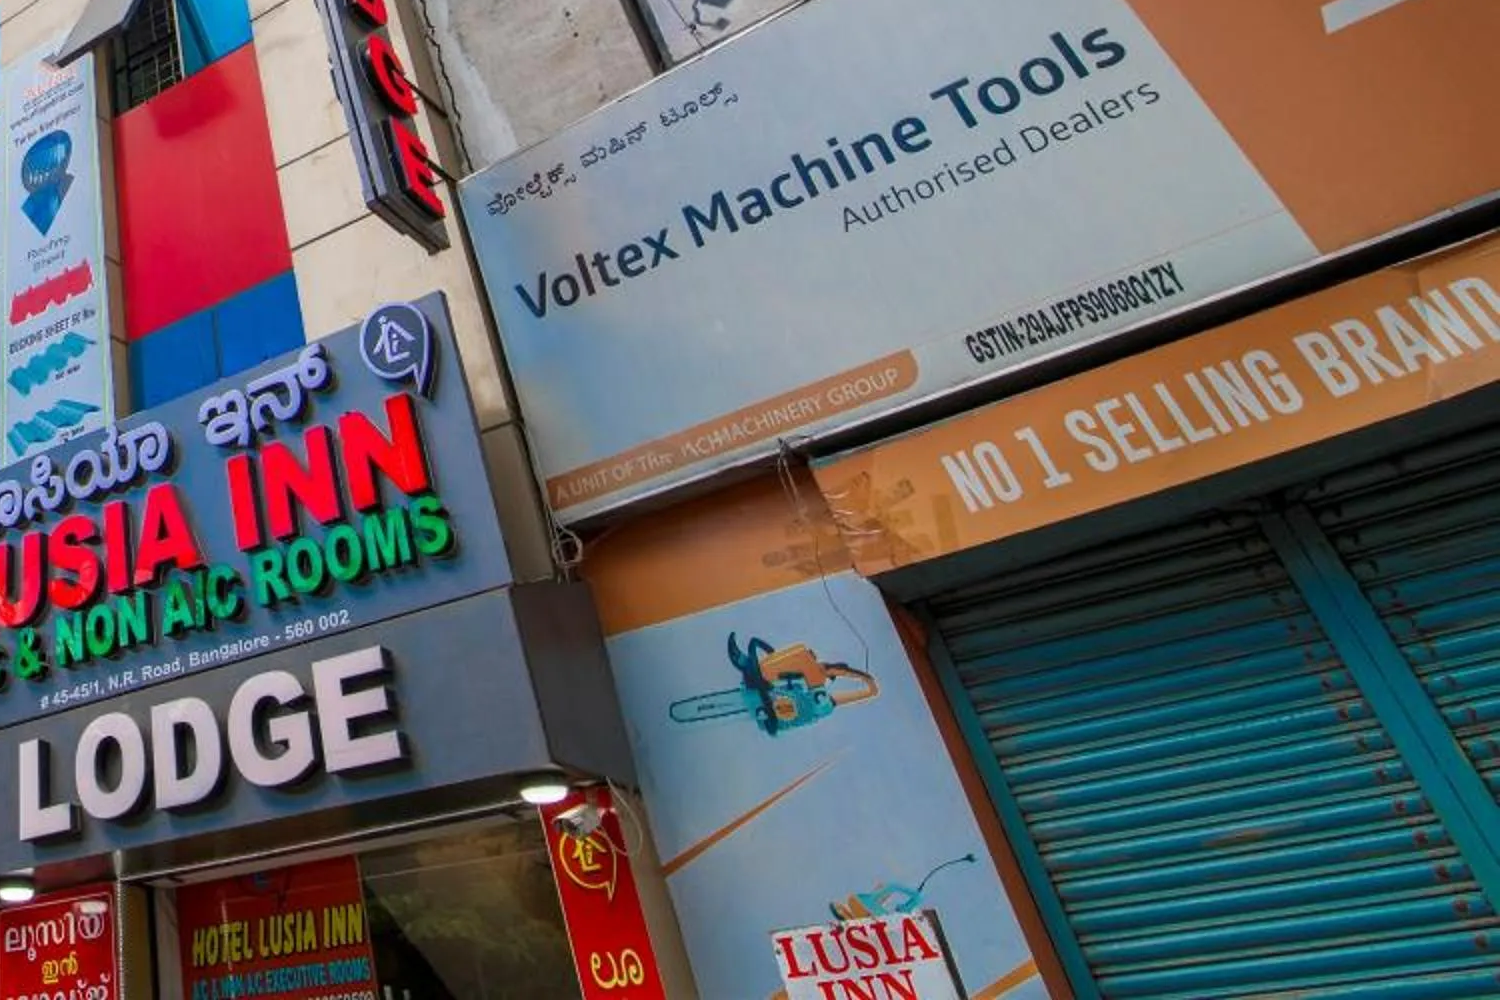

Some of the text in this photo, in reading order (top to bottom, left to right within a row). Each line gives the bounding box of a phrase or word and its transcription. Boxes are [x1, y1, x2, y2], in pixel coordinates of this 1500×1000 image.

[515, 26, 1127, 320] Voltex Machine Tools
[841, 77, 1161, 233] Authorised Dealers
[199, 342, 330, 446] ಇನ್
[827, 366, 900, 408] GROUP
[941, 275, 1500, 513] NO 1 SELLING BRAND
[226, 392, 431, 552] INN
[14, 627, 44, 680] &
[55, 589, 150, 668] NON
[162, 563, 241, 640] A/C
[254, 495, 452, 609] ROOMS
[109, 672, 136, 692] N.R.
[142, 656, 186, 681] Road,
[189, 633, 270, 668] Bangalore
[284, 622, 315, 642] 560
[318, 609, 351, 633] 002
[18, 644, 403, 843] LODGE
[191, 903, 364, 968] HOTEL LUSIA INN
[777, 917, 940, 979] LUSIA
